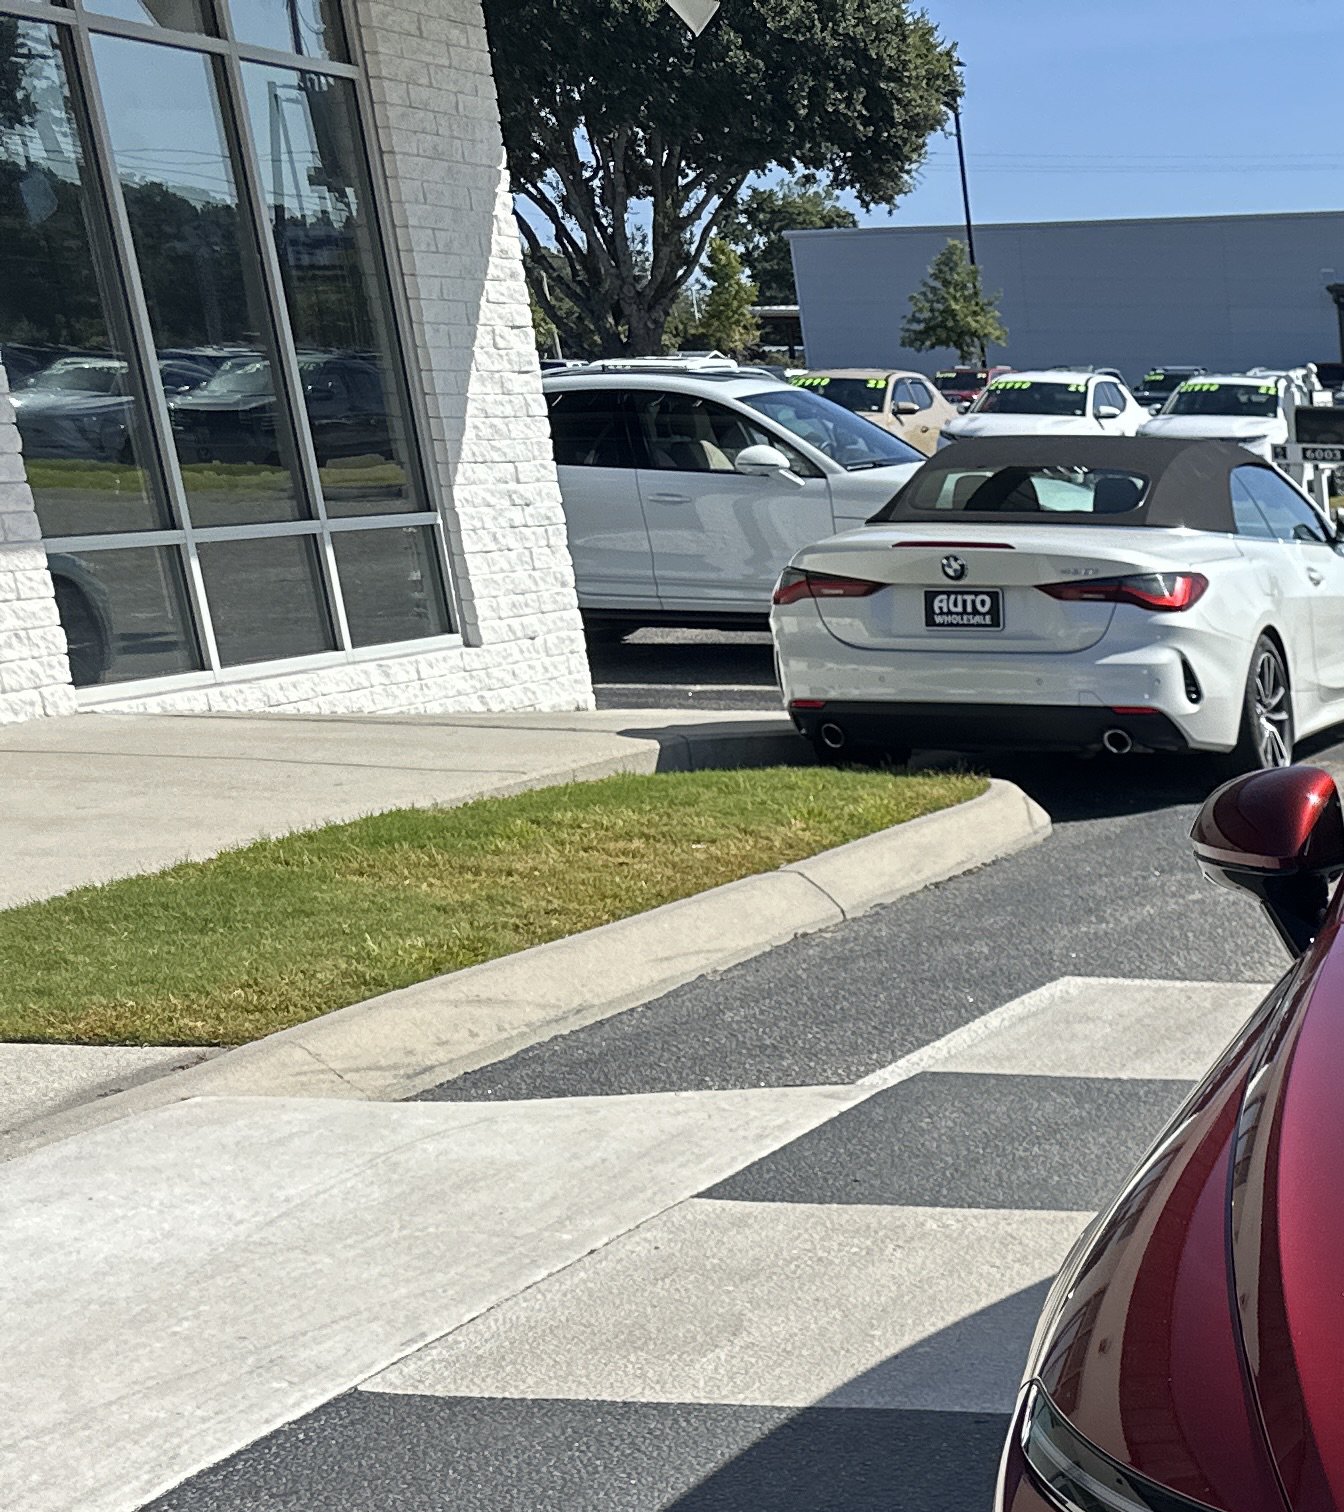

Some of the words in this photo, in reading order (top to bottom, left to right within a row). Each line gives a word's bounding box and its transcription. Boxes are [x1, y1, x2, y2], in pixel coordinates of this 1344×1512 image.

[1305, 449, 1342, 460] 6003
[933, 594, 992, 614] AUTO
[934, 614, 992, 625] WHOLESALE
